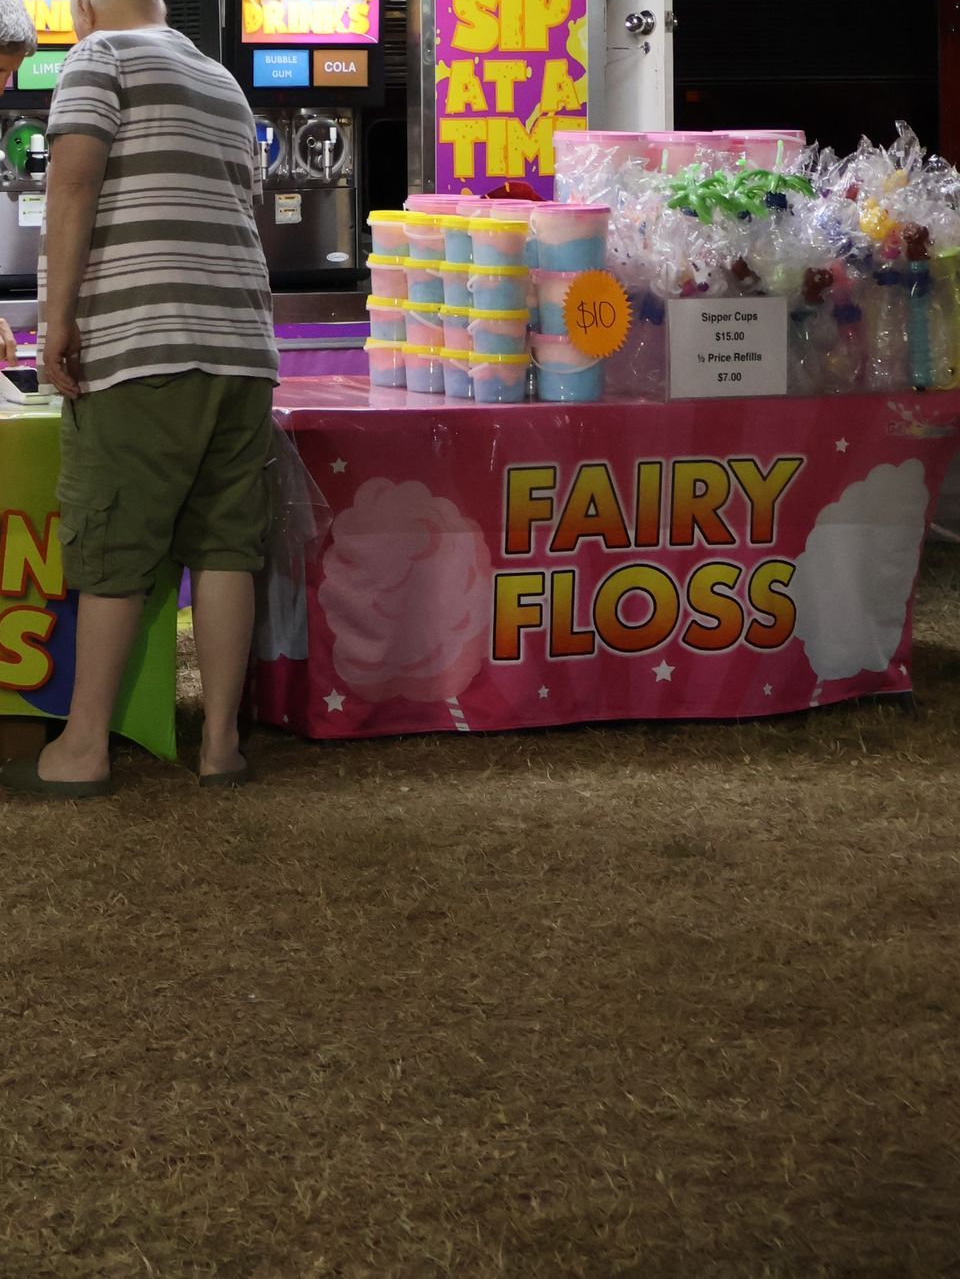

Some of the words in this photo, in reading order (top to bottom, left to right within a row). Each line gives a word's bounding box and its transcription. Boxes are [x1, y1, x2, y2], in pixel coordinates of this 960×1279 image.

[265, 55, 298, 64] BUBBLE
[33, 63, 62, 75] LIME
[324, 61, 357, 73] COLA
[271, 69, 293, 78] GUM
[446, 59, 528, 113] AT
[540, 57, 582, 112] A
[575, 299, 616, 334] $10
[701, 312, 732, 323] Sipper
[734, 311, 758, 322] Cups
[715, 331, 745, 342] $15.00
[708, 353, 732, 363] Price
[733, 352, 762, 362] Refills
[717, 372, 742, 382] $7.00
[503, 457, 805, 556] FAIRY
[490, 559, 798, 662] FLOSS
